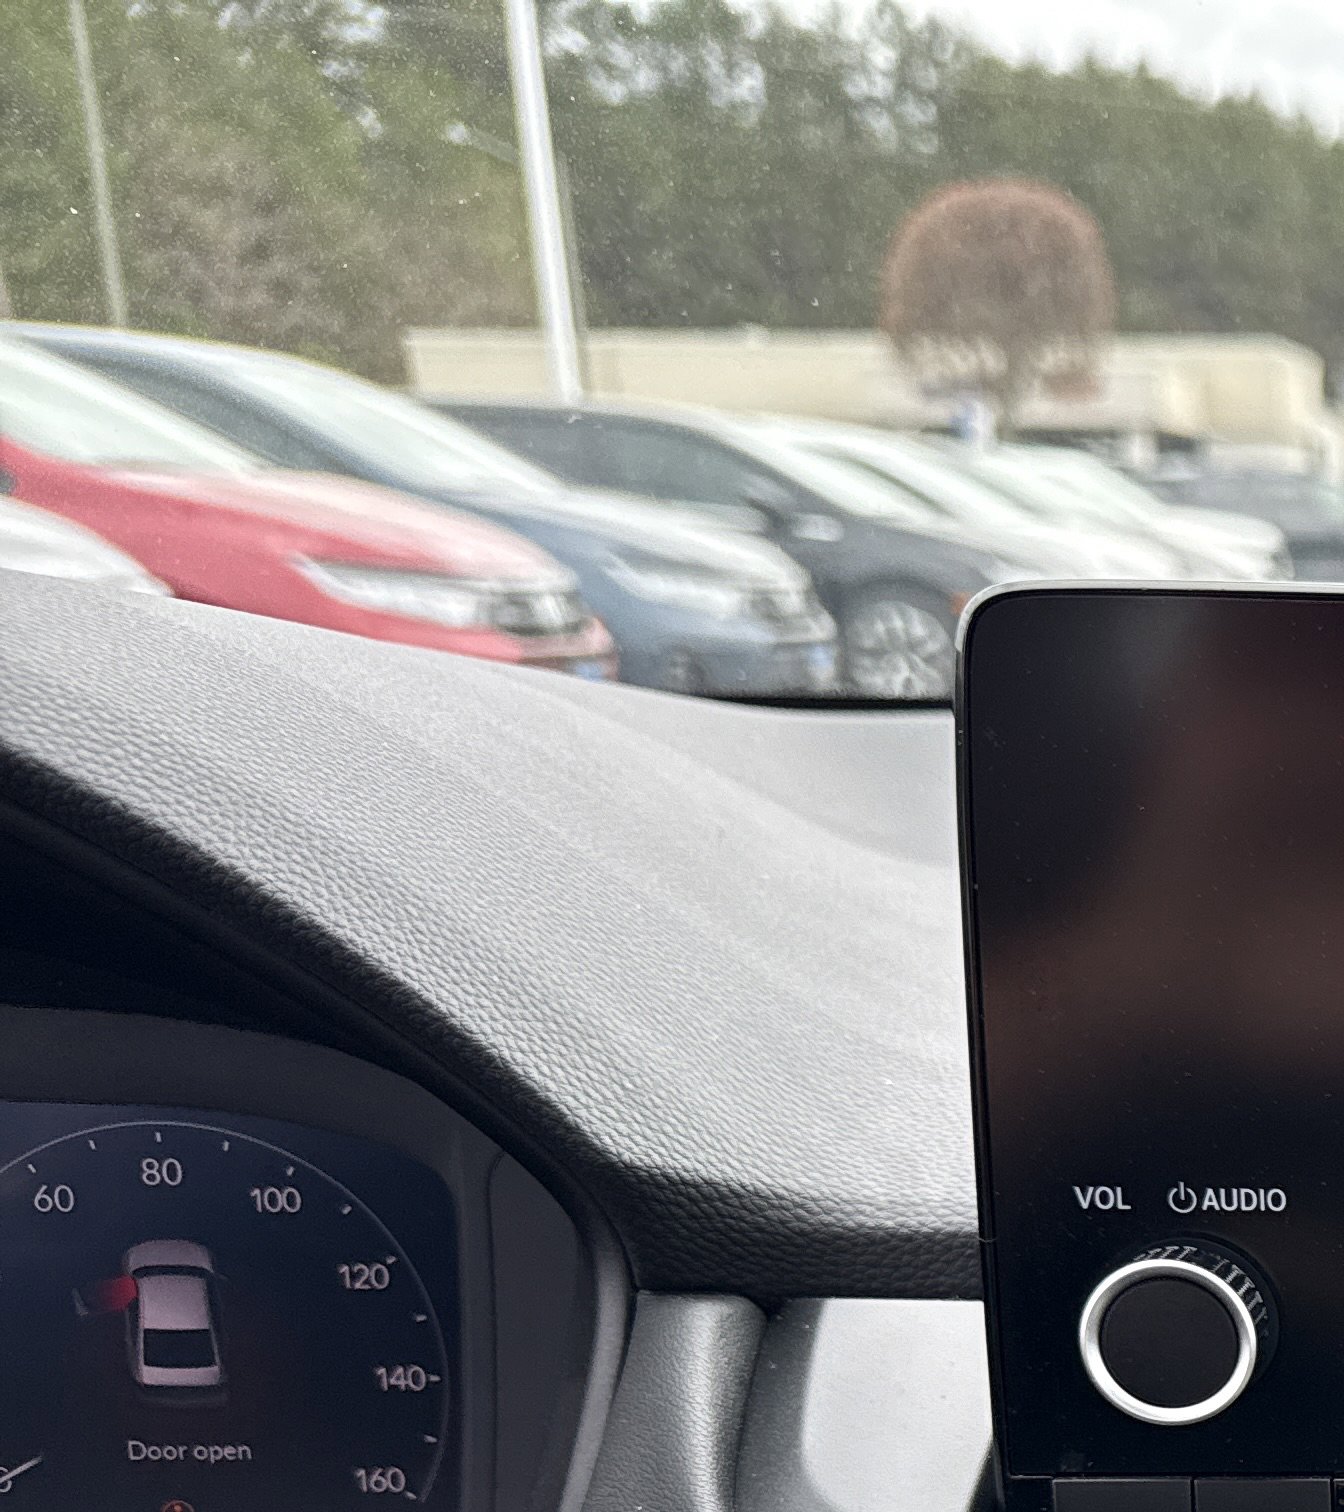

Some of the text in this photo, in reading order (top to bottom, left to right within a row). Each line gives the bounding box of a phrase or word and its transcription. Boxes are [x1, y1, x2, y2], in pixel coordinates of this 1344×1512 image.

[141, 1157, 183, 1186] 80
[33, 1184, 75, 1213] 60
[250, 1186, 302, 1213] 100
[1073, 1185, 1287, 1212] VOL AUDIO
[338, 1264, 390, 1290] 120
[375, 1365, 427, 1391] 140
[127, 1440, 252, 1464] Door open
[355, 1467, 406, 1493] 160
